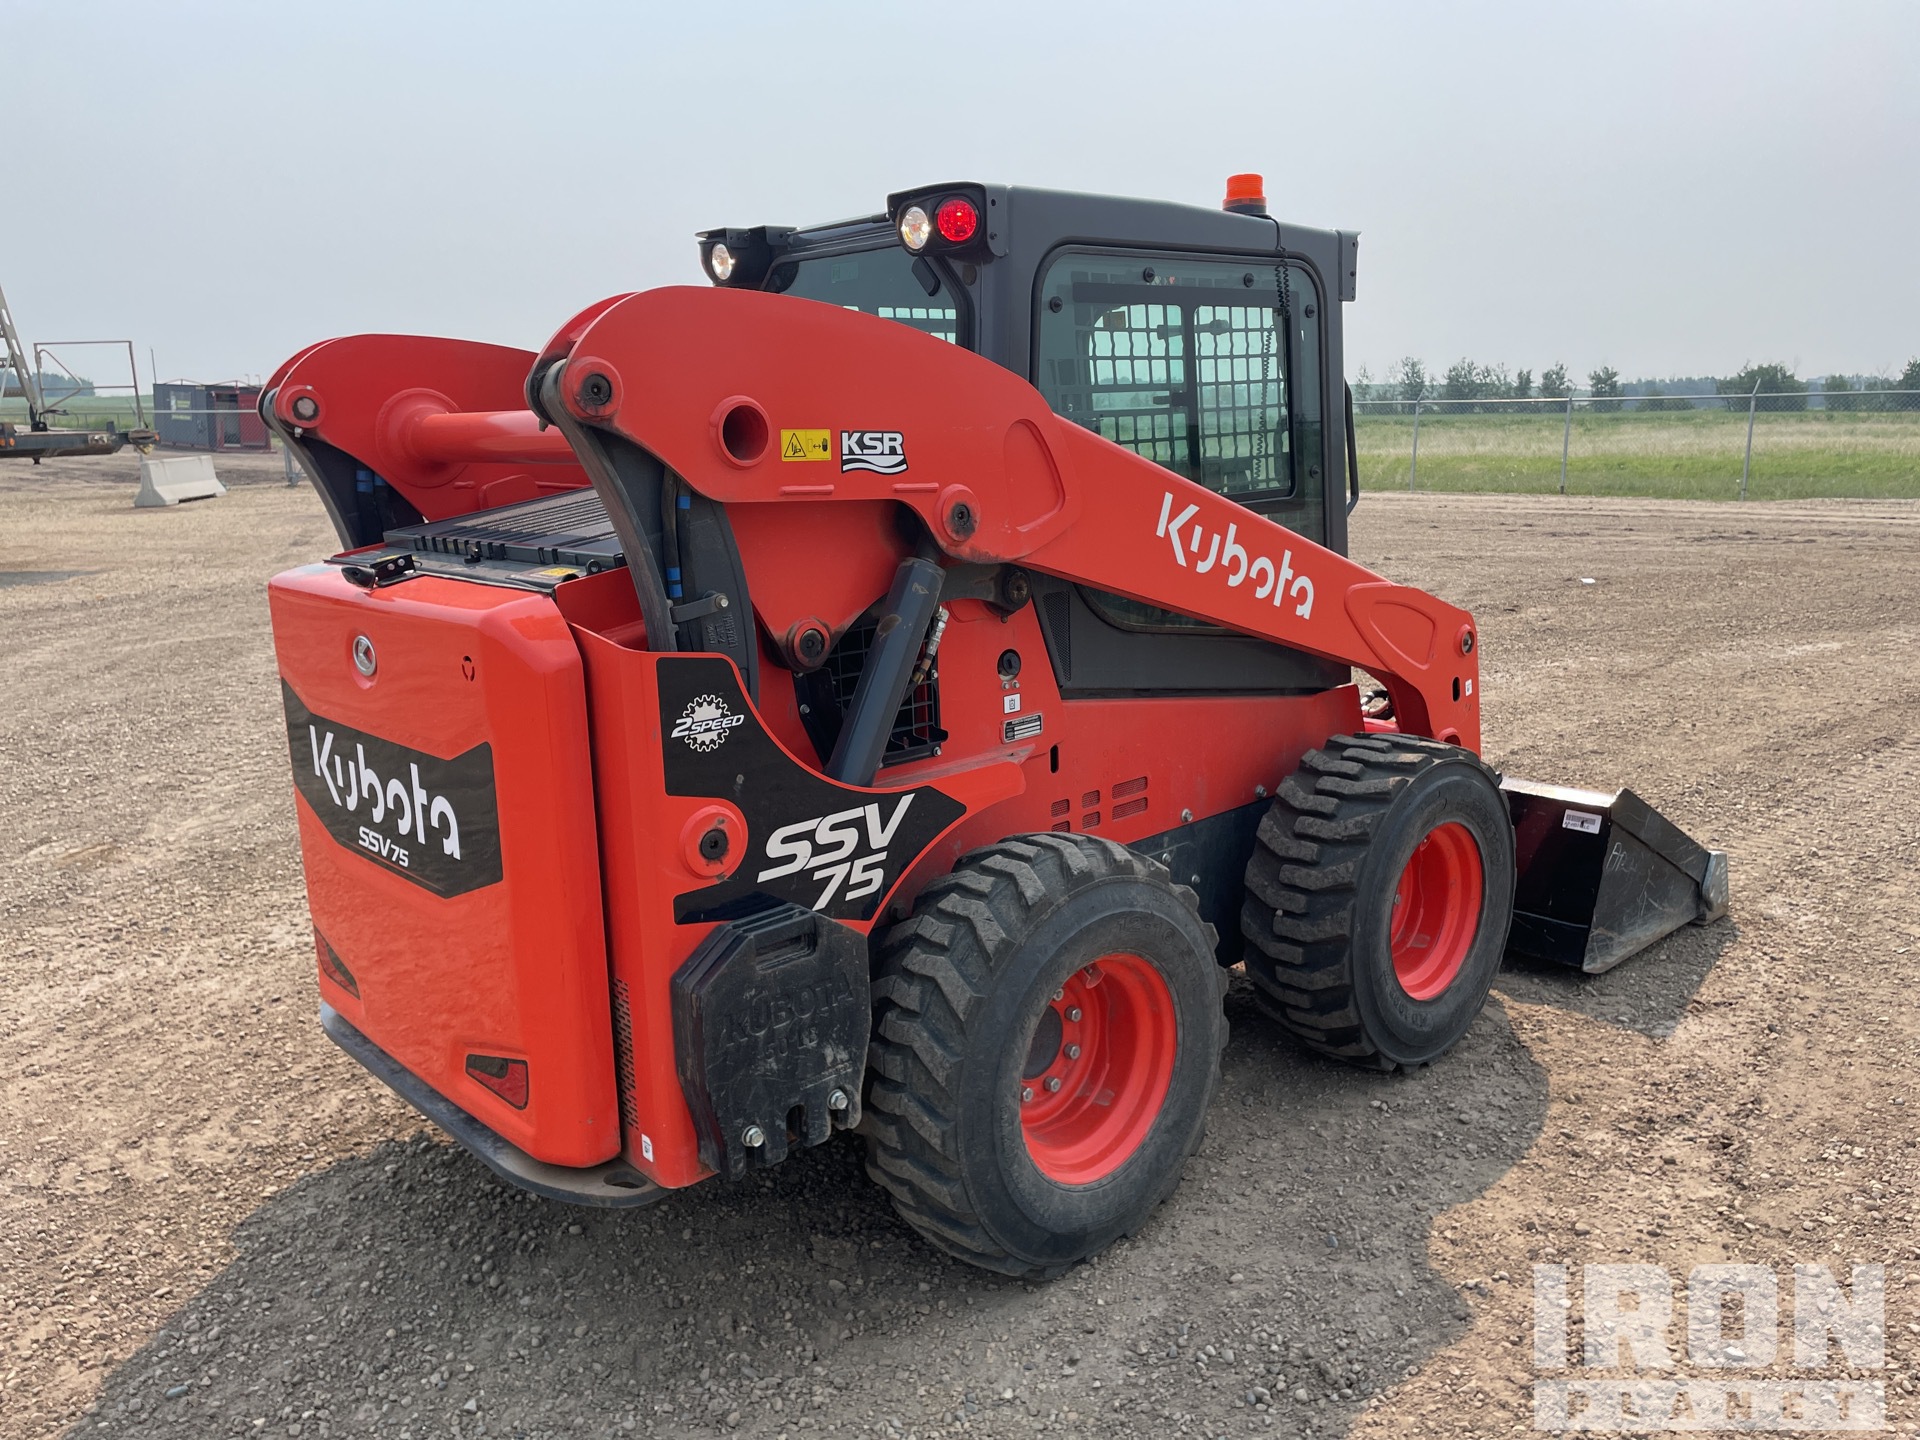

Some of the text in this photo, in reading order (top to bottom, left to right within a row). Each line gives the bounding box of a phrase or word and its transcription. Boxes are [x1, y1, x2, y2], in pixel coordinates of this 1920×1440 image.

[841, 432, 904, 455] KSR
[1156, 491, 1315, 620] Kubota
[309, 725, 461, 861] Kubota
[757, 793, 916, 883] SSV
[812, 851, 888, 912] 75
